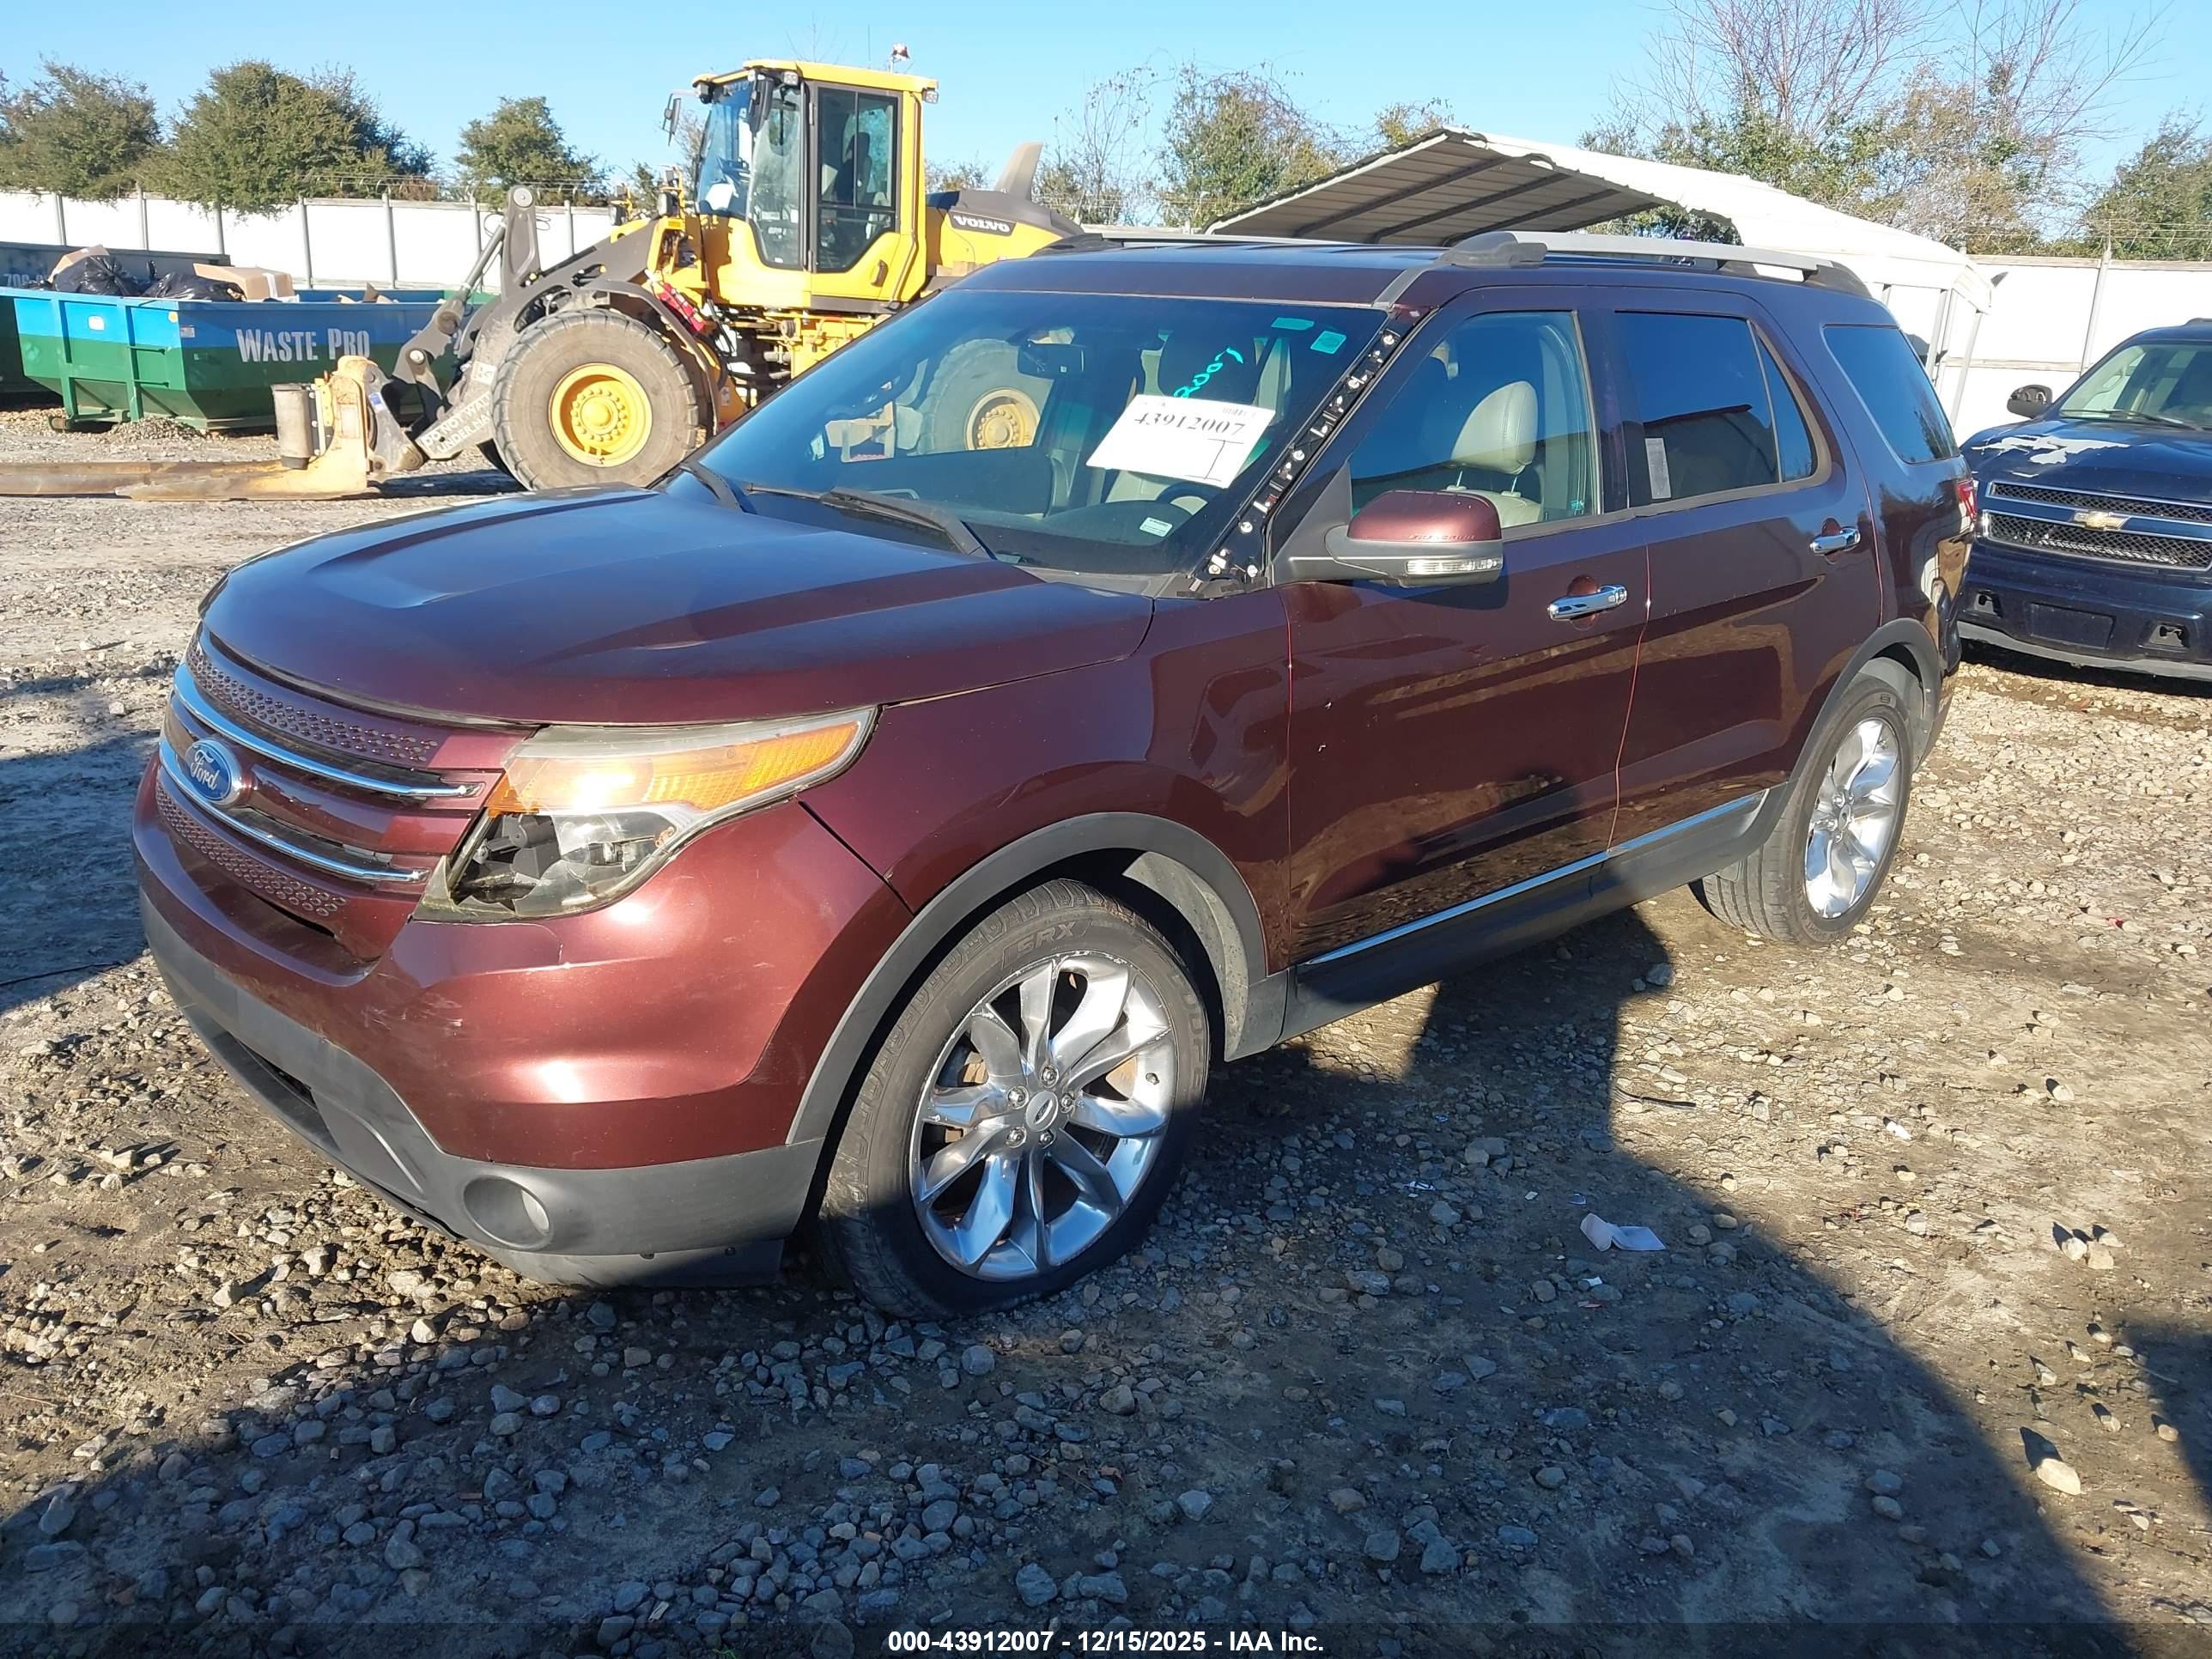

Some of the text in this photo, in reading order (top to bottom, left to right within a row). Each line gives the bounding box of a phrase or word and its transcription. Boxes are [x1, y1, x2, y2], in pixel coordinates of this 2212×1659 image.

[953, 216, 1011, 233] VOLVO
[235, 328, 370, 363] WASTE PRO
[422, 429, 441, 447] DO
[440, 414, 465, 434] NOT
[436, 425, 473, 453] UNDER
[1134, 412, 1246, 436] 43912007
[190, 749, 221, 791] Ford
